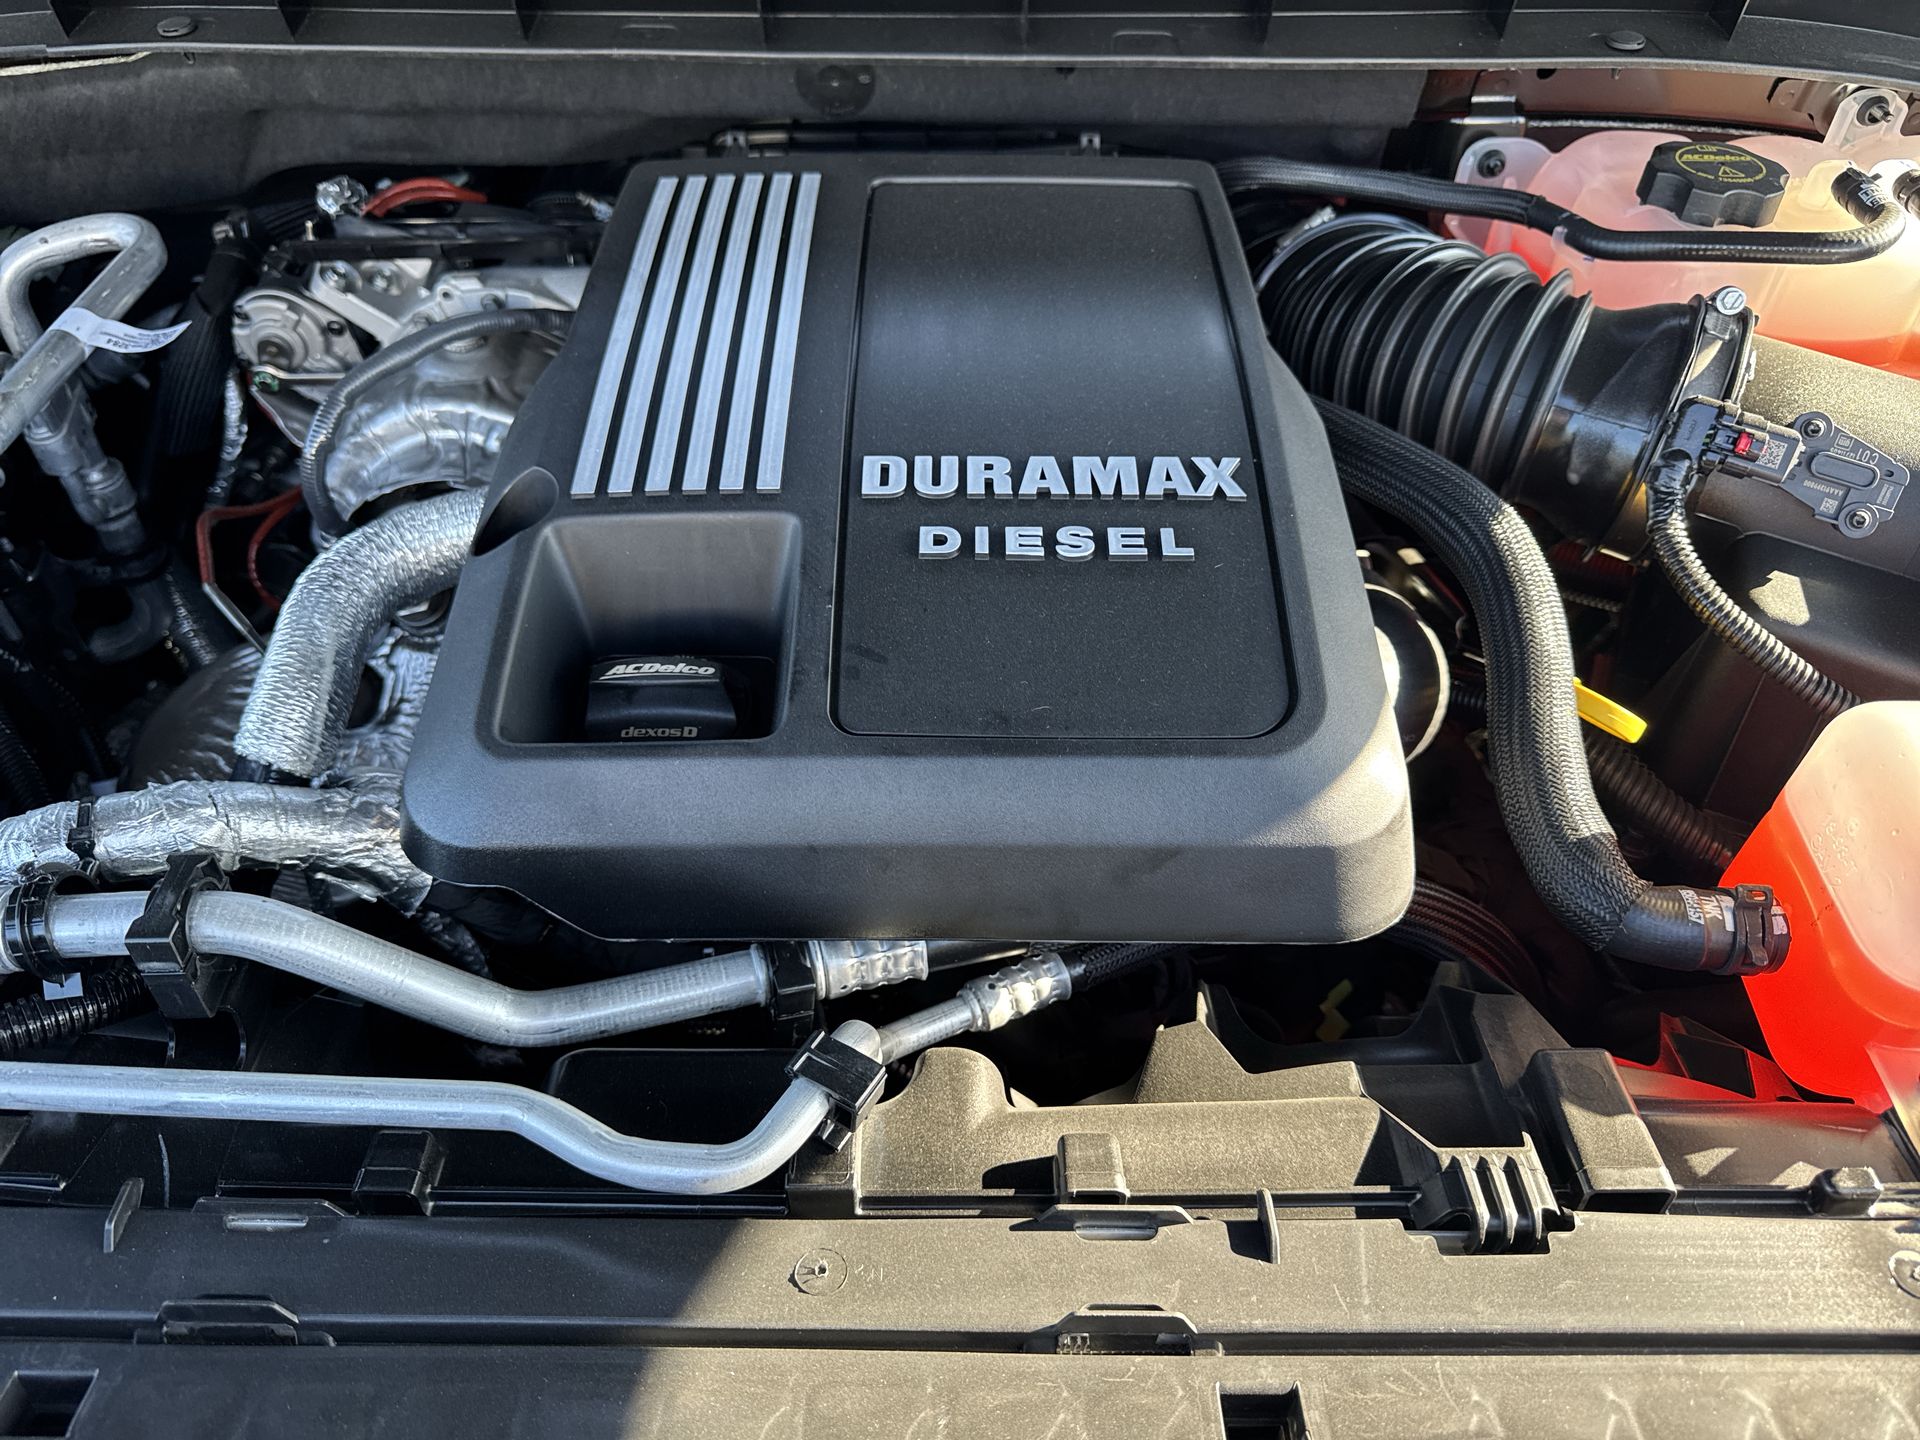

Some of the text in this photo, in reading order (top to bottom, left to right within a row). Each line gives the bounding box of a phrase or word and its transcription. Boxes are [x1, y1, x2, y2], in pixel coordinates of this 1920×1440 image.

[1857, 449, 1879, 465] C01
[861, 455, 1247, 501] DURAMAX
[918, 525, 1195, 561] DIESEL
[604, 662, 716, 677] ACDelco
